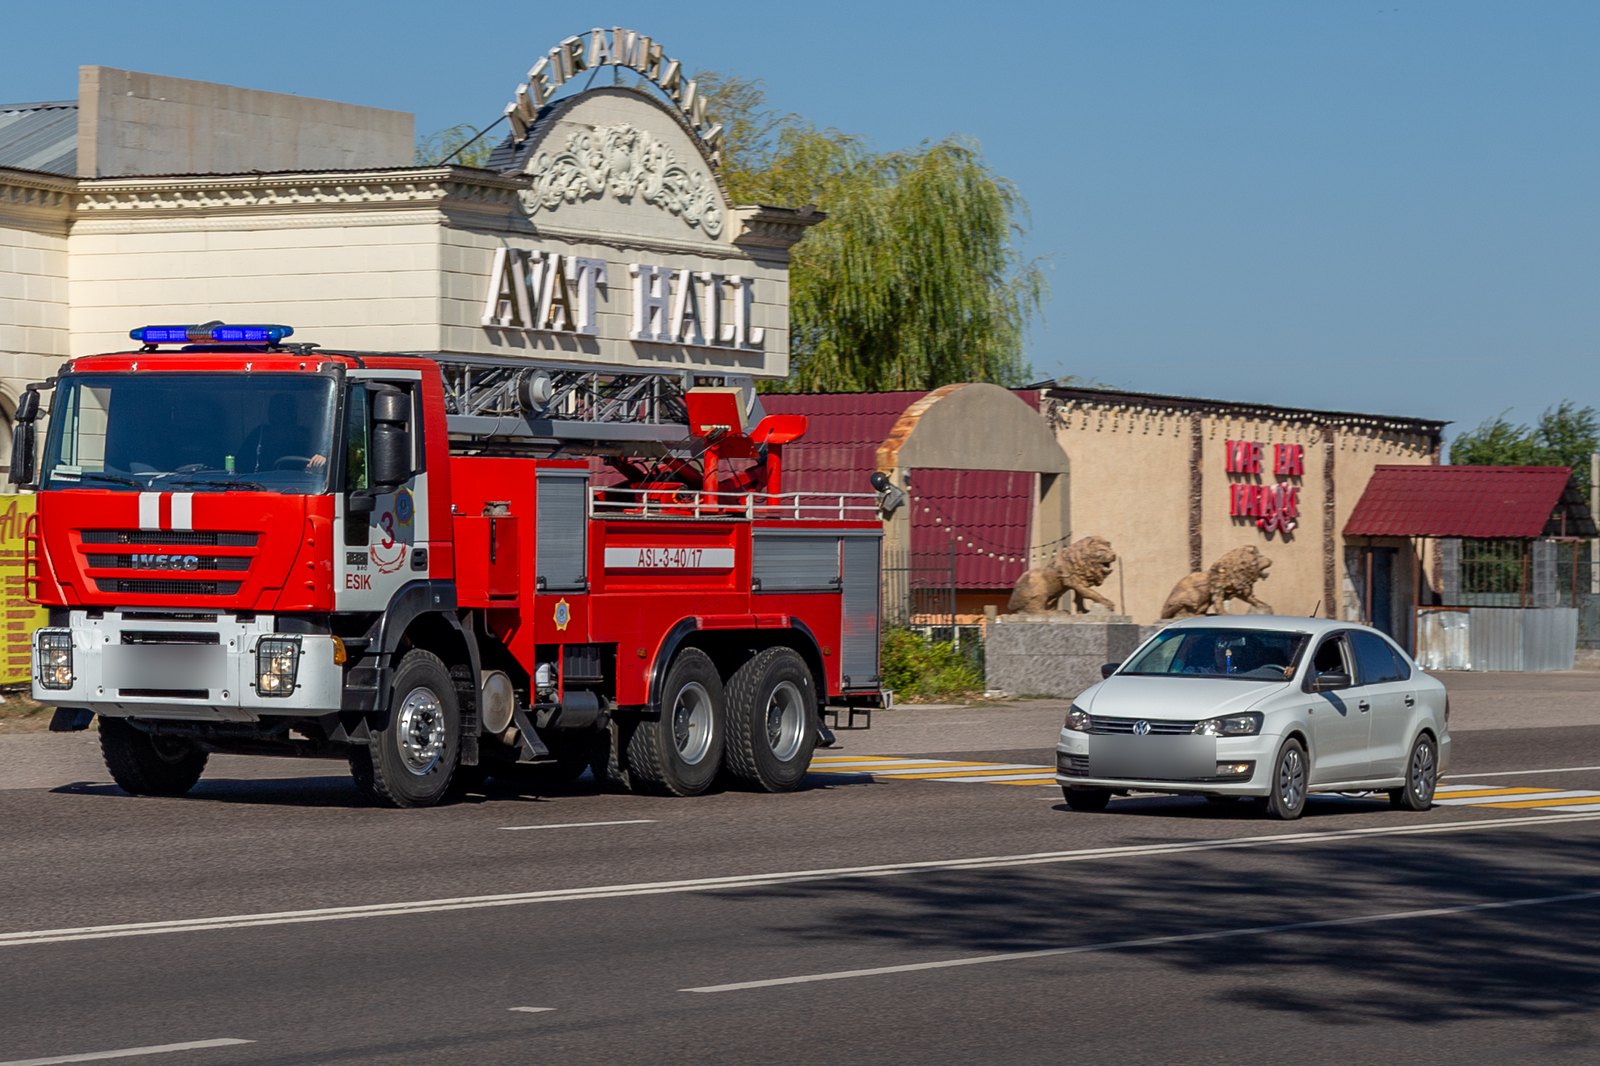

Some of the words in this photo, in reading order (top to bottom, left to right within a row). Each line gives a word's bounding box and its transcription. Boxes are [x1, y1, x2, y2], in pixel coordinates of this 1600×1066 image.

[481, 247, 608, 337] AVAT
[629, 263, 765, 350] HALL
[381, 511, 395, 549] 3
[131, 554, 199, 570] IVECO
[637, 549, 703, 568] ASL-3-40/17
[345, 574, 372, 590] ESIK
